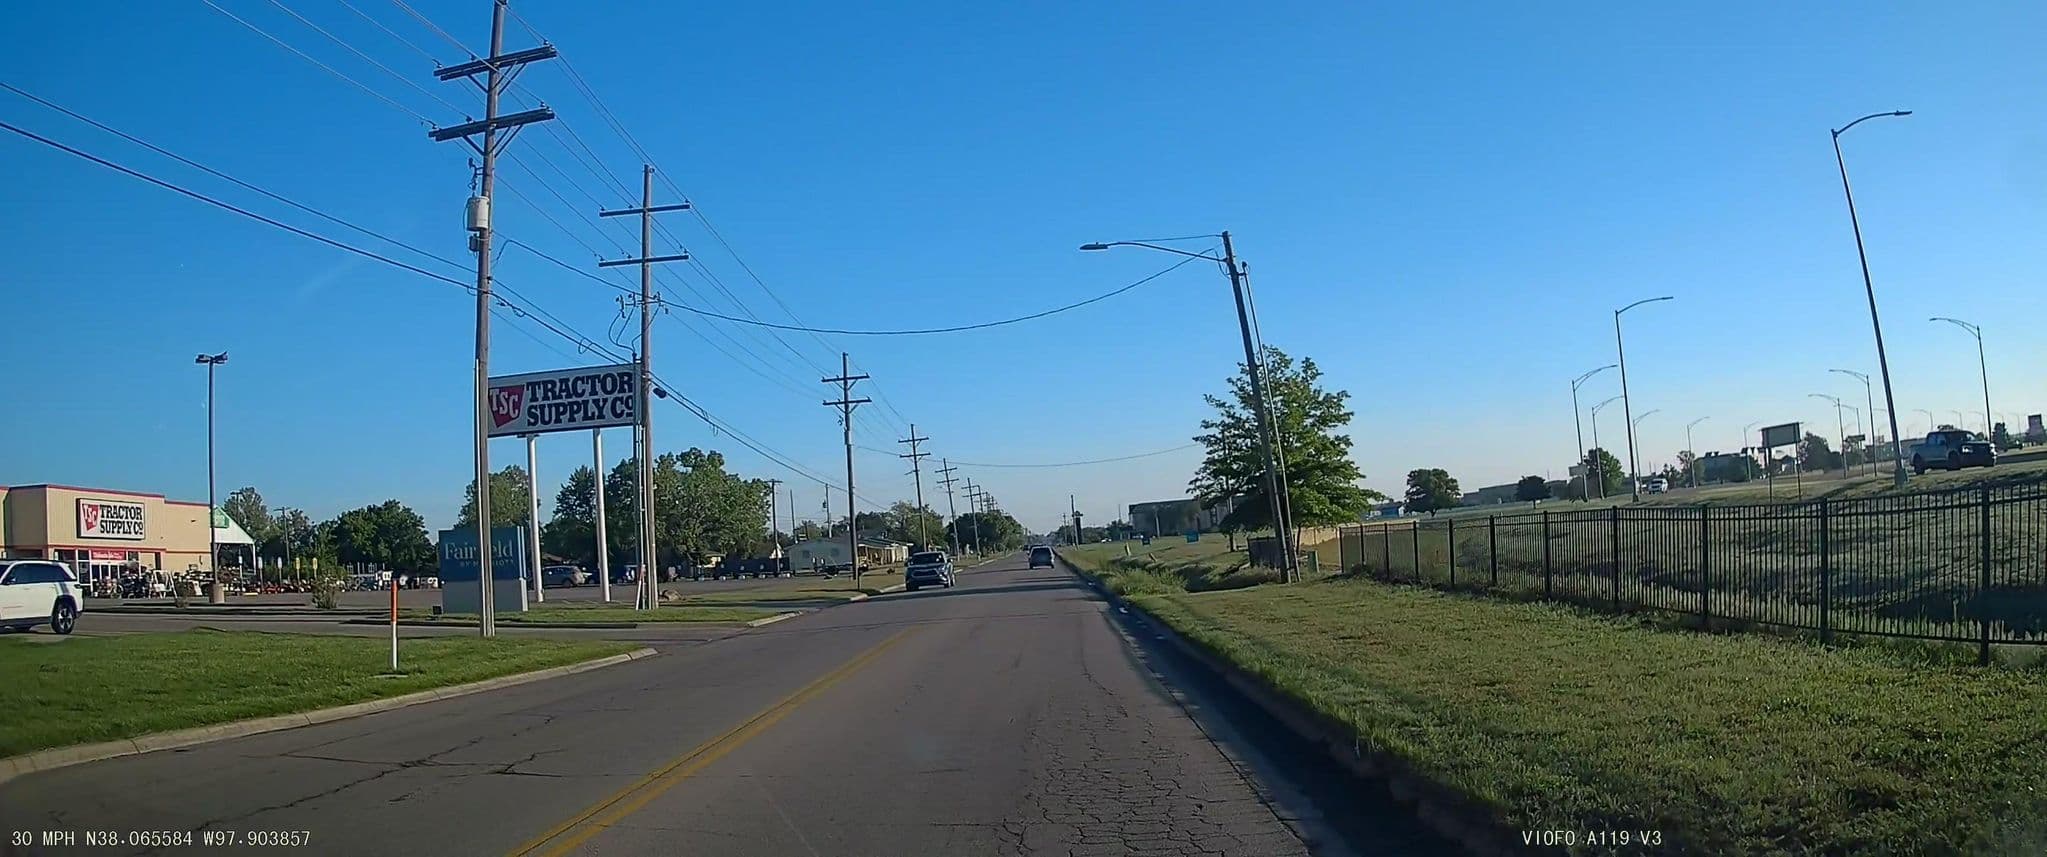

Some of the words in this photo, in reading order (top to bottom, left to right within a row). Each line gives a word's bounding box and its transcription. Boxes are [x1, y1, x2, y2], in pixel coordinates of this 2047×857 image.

[526, 372, 633, 402] TRACTOR
[489, 388, 519, 419] TSC
[527, 397, 608, 427] SUPPLY
[83, 504, 97, 526] TSC
[100, 505, 142, 520] TRACTOR
[100, 520, 133, 534] SUPPLY
[445, 539, 513, 560] Faireld
